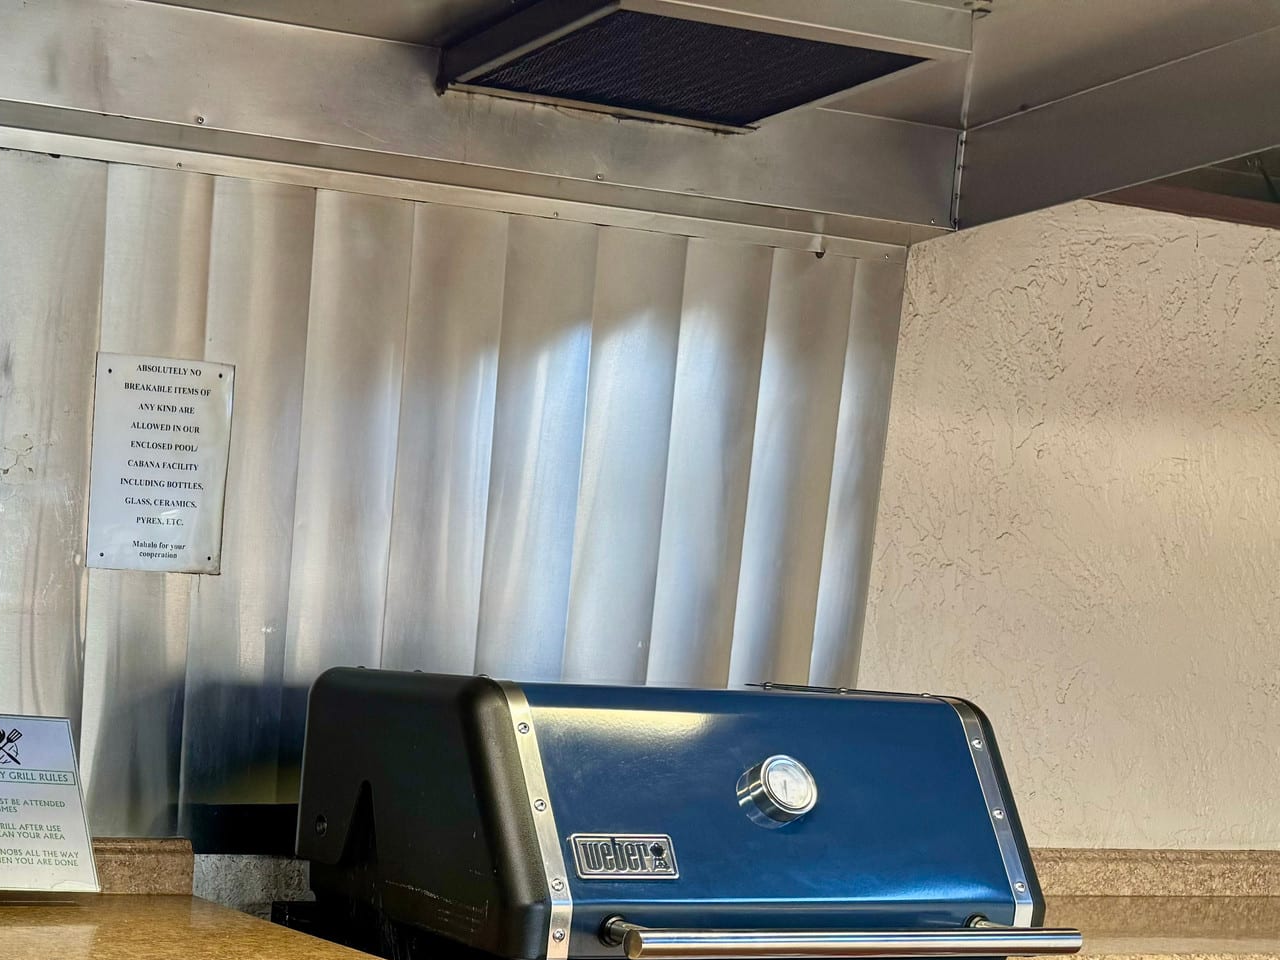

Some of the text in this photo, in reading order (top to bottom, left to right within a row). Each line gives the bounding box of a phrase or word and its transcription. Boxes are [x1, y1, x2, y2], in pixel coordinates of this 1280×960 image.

[136, 364, 188, 376] ABSOLUTELY
[124, 382, 211, 397] BREAKABLE ITEMS OF
[138, 403, 195, 414] ANY KIND ARE
[131, 422, 171, 431] ALLOWED
[130, 440, 199, 452] ENCLOSED POOL/
[127, 459, 199, 471] CABANA FACILITY
[120, 477, 204, 490] INCLUDING BOTTLES,
[125, 497, 153, 506] GLASS,
[132, 540, 157, 549] Mahalo
[139, 551, 178, 559] cooperation
[9, 771, 37, 781] GRILL
[39, 773, 68, 782] RULES
[22, 799, 65, 808] ATTENDED
[19, 823, 44, 831] AFTER
[17, 831, 41, 839] YOUR
[43, 850, 58, 858] THE
[580, 837, 650, 872] weber
[14, 857, 34, 865] YOU
[55, 859, 79, 867] DONE
